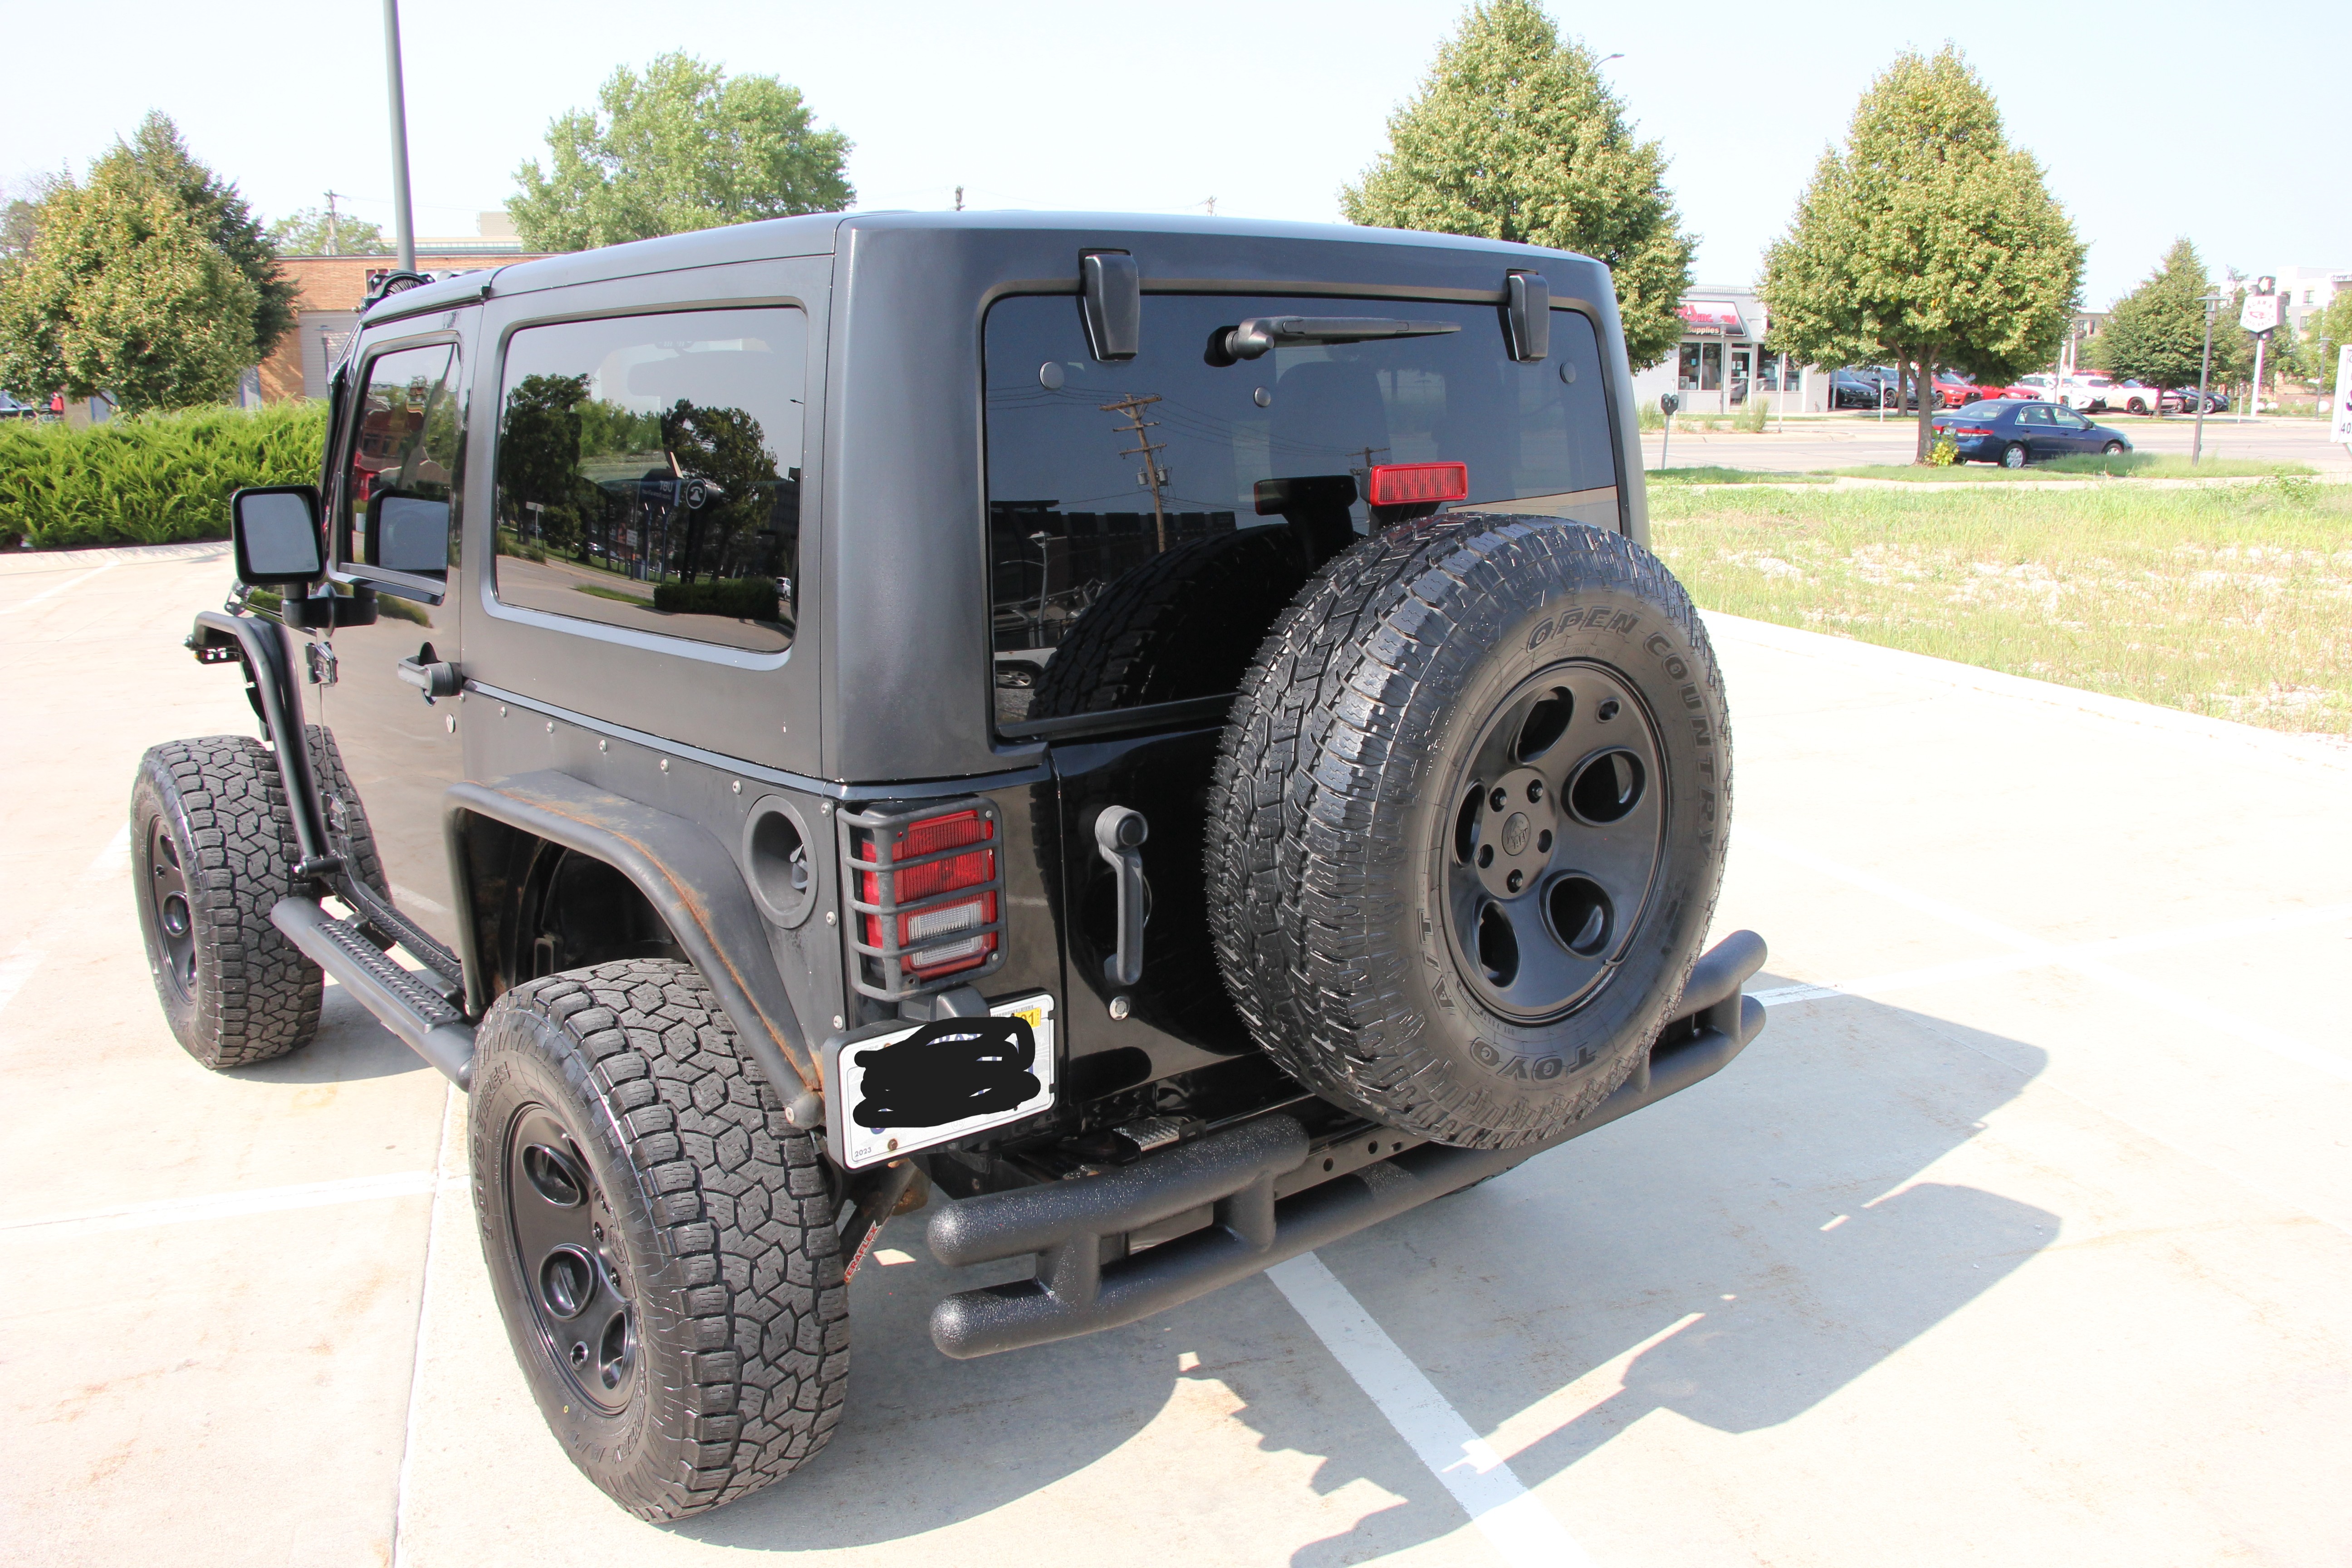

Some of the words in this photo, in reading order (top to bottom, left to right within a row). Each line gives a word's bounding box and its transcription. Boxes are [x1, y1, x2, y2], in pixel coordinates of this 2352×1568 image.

[2341, 422, 2352, 434] 40
[1527, 607, 1640, 652] OPEN
[1643, 632, 1715, 866] COUNTRY
[1470, 1037, 1597, 1083] TOYO
[476, 1060, 510, 1133] TIRES
[854, 1147, 872, 1157] 2023
[474, 1132, 492, 1241] TOYO
